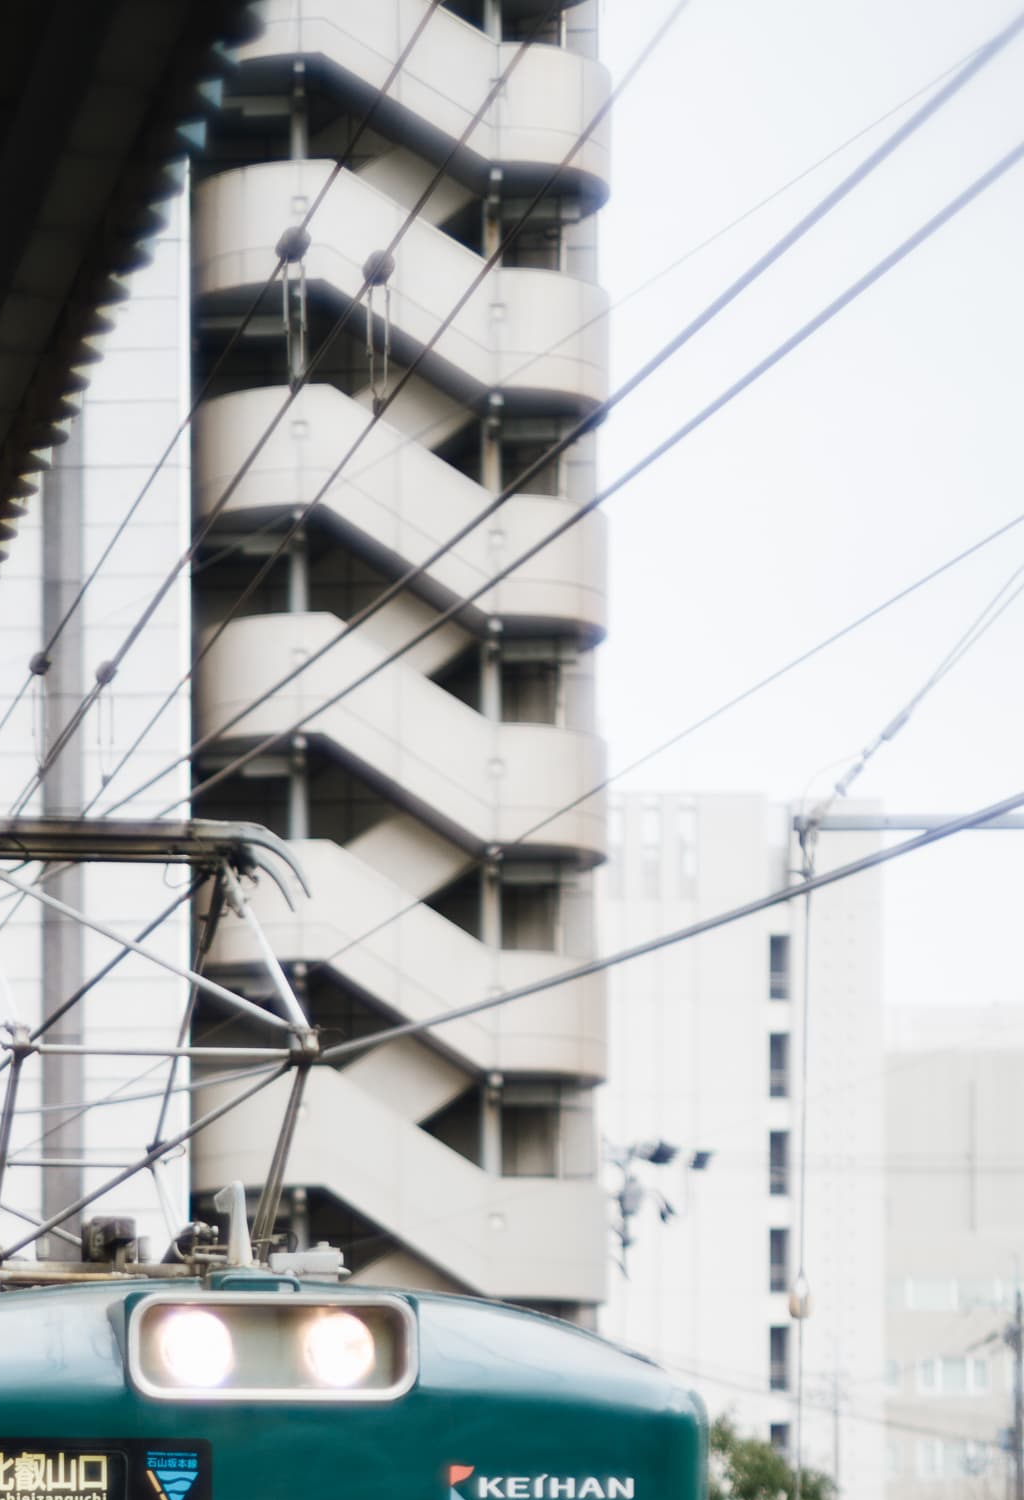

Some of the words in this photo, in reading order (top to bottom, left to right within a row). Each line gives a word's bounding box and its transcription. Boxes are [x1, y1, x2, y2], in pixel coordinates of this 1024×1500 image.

[147, 1457, 198, 1469] 石山坂本線
[478, 1473, 635, 1500] KEIHAN
